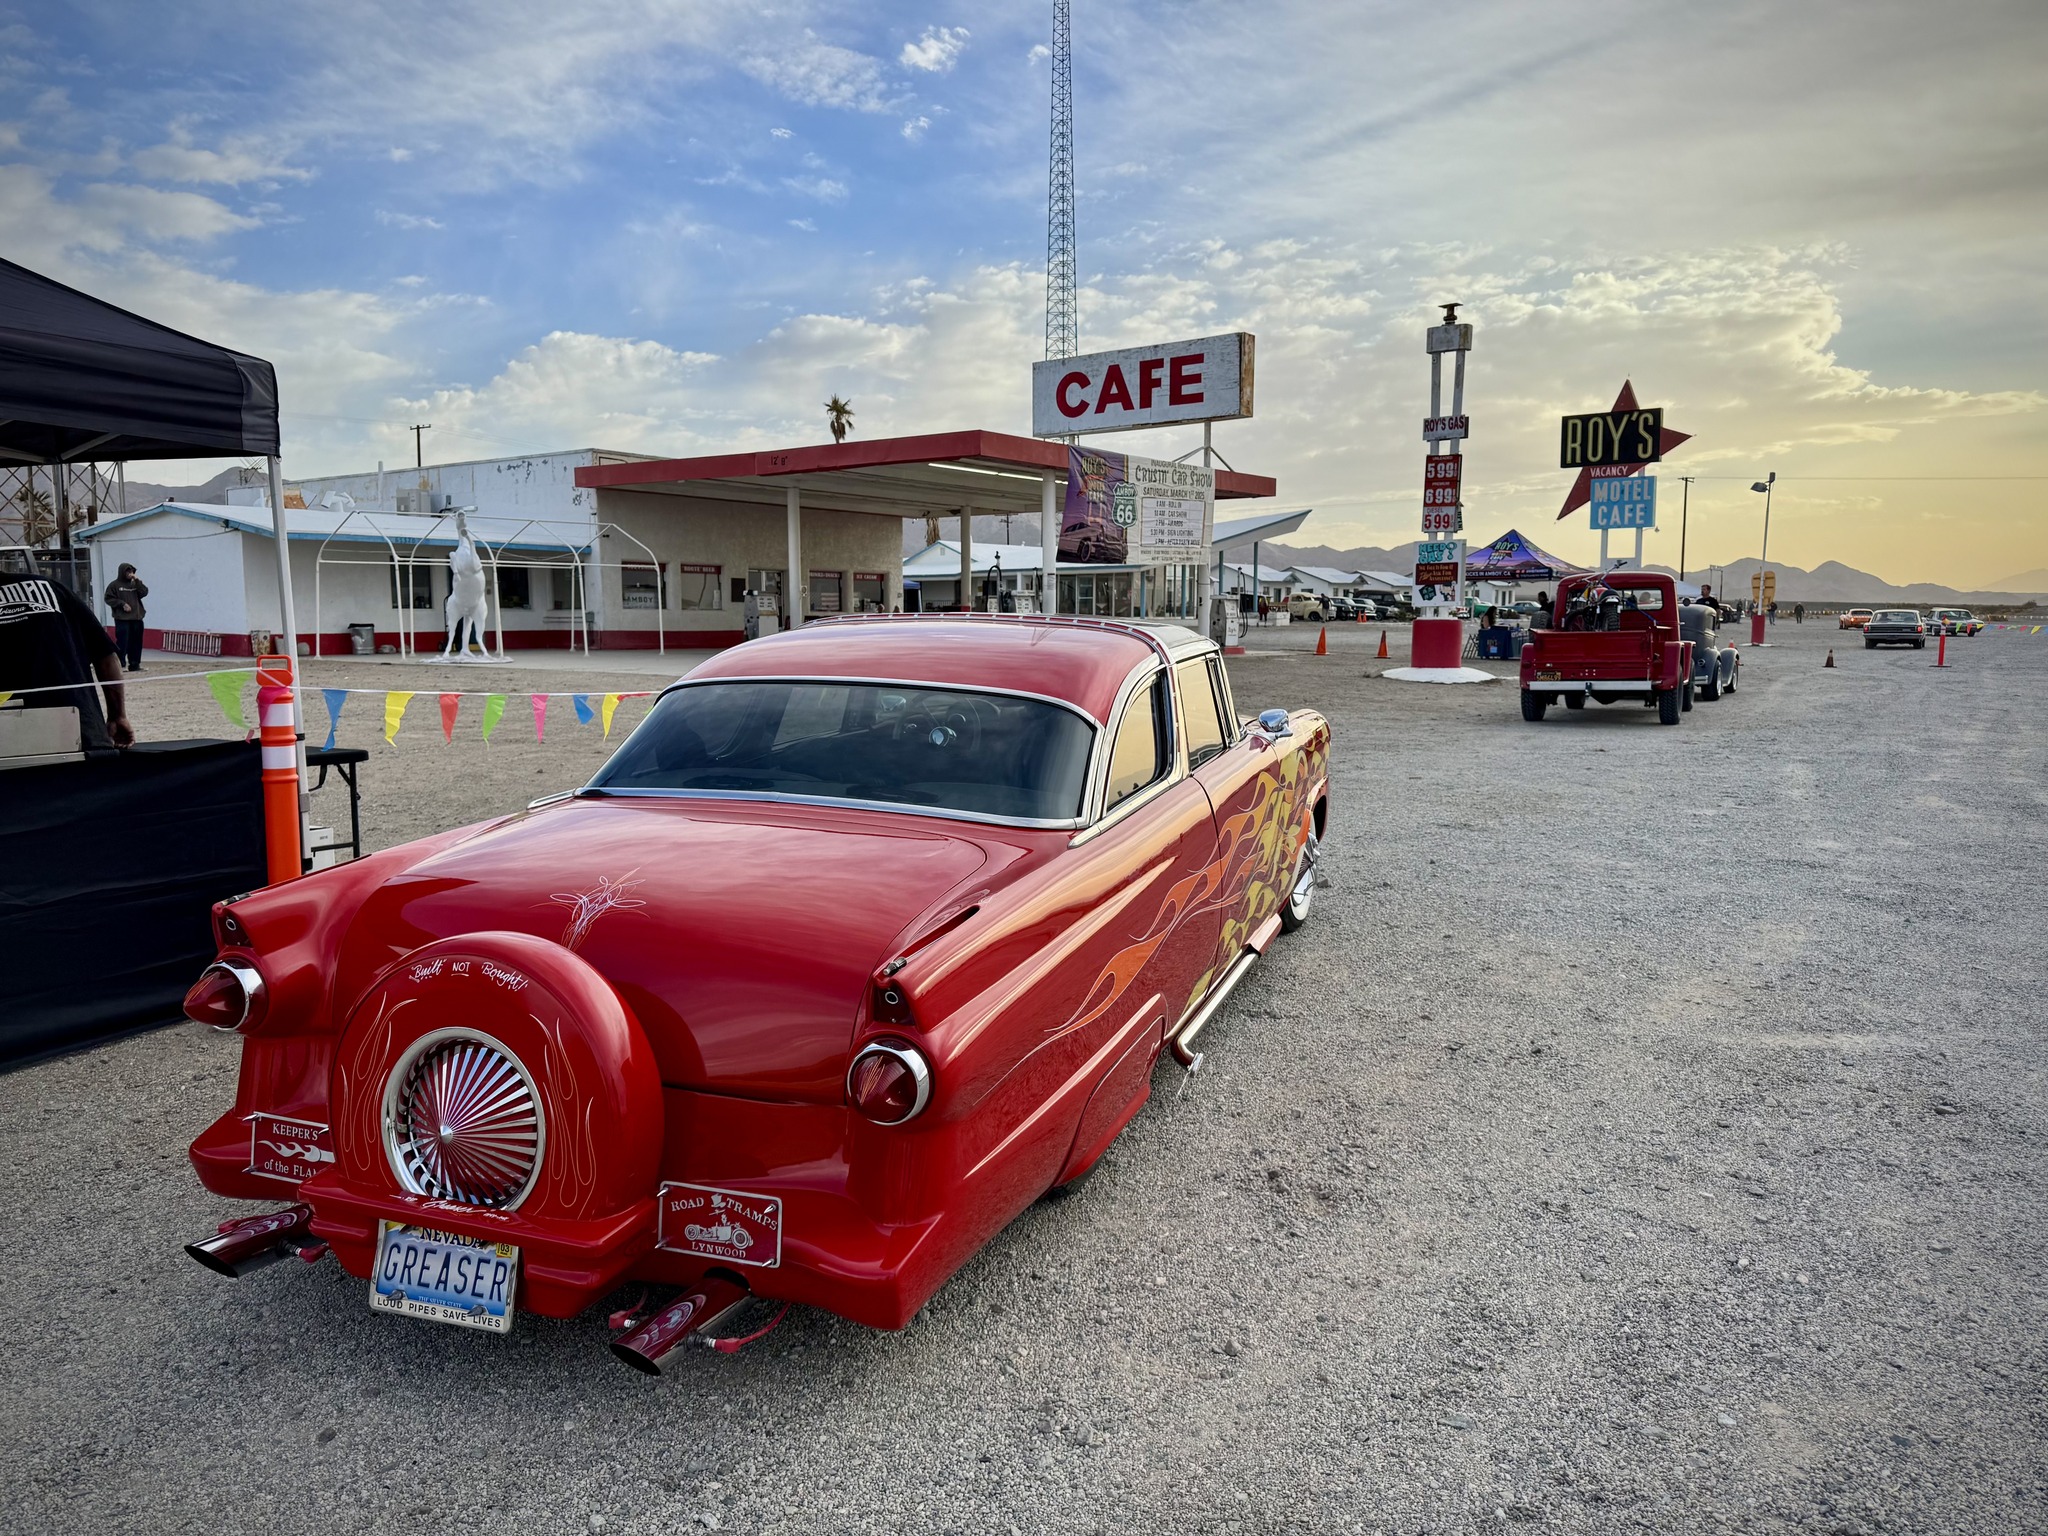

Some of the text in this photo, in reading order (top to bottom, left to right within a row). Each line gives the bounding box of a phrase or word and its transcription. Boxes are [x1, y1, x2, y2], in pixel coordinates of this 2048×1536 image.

[1056, 353, 1205, 418] CAFE
[1424, 415, 1464, 432] ROY'S GAS
[1566, 411, 1654, 464] ROY'S
[1172, 469, 1187, 485] CAR
[1190, 471, 1213, 487] SHOW
[1590, 466, 1628, 477] VACANCY
[1116, 486, 1135, 497] AMBOY
[1170, 489, 1187, 498] MARCH
[1425, 488, 1452, 504] 699
[1594, 480, 1651, 503] MOTEL
[1117, 505, 1133, 523] 66
[1424, 514, 1450, 529] 599
[1597, 503, 1645, 526] CAFE
[1419, 543, 1446, 555] NEED
[1494, 541, 1519, 551] ROY'S
[452, 962, 470, 972] NOT
[272, 1123, 318, 1141] KEEPER'S
[264, 1159, 274, 1170] of
[275, 1161, 289, 1174] the
[671, 1197, 778, 1231] ROAD TRAMPS
[420, 1227, 484, 1250] NEVADA
[500, 1243, 509, 1252] 03
[691, 1241, 746, 1259] LYNWOOD
[384, 1244, 508, 1302] GREASER
[430, 1297, 446, 1305] SILVER
[377, 1297, 501, 1328] LOUD PIPES SAVE LIVES
